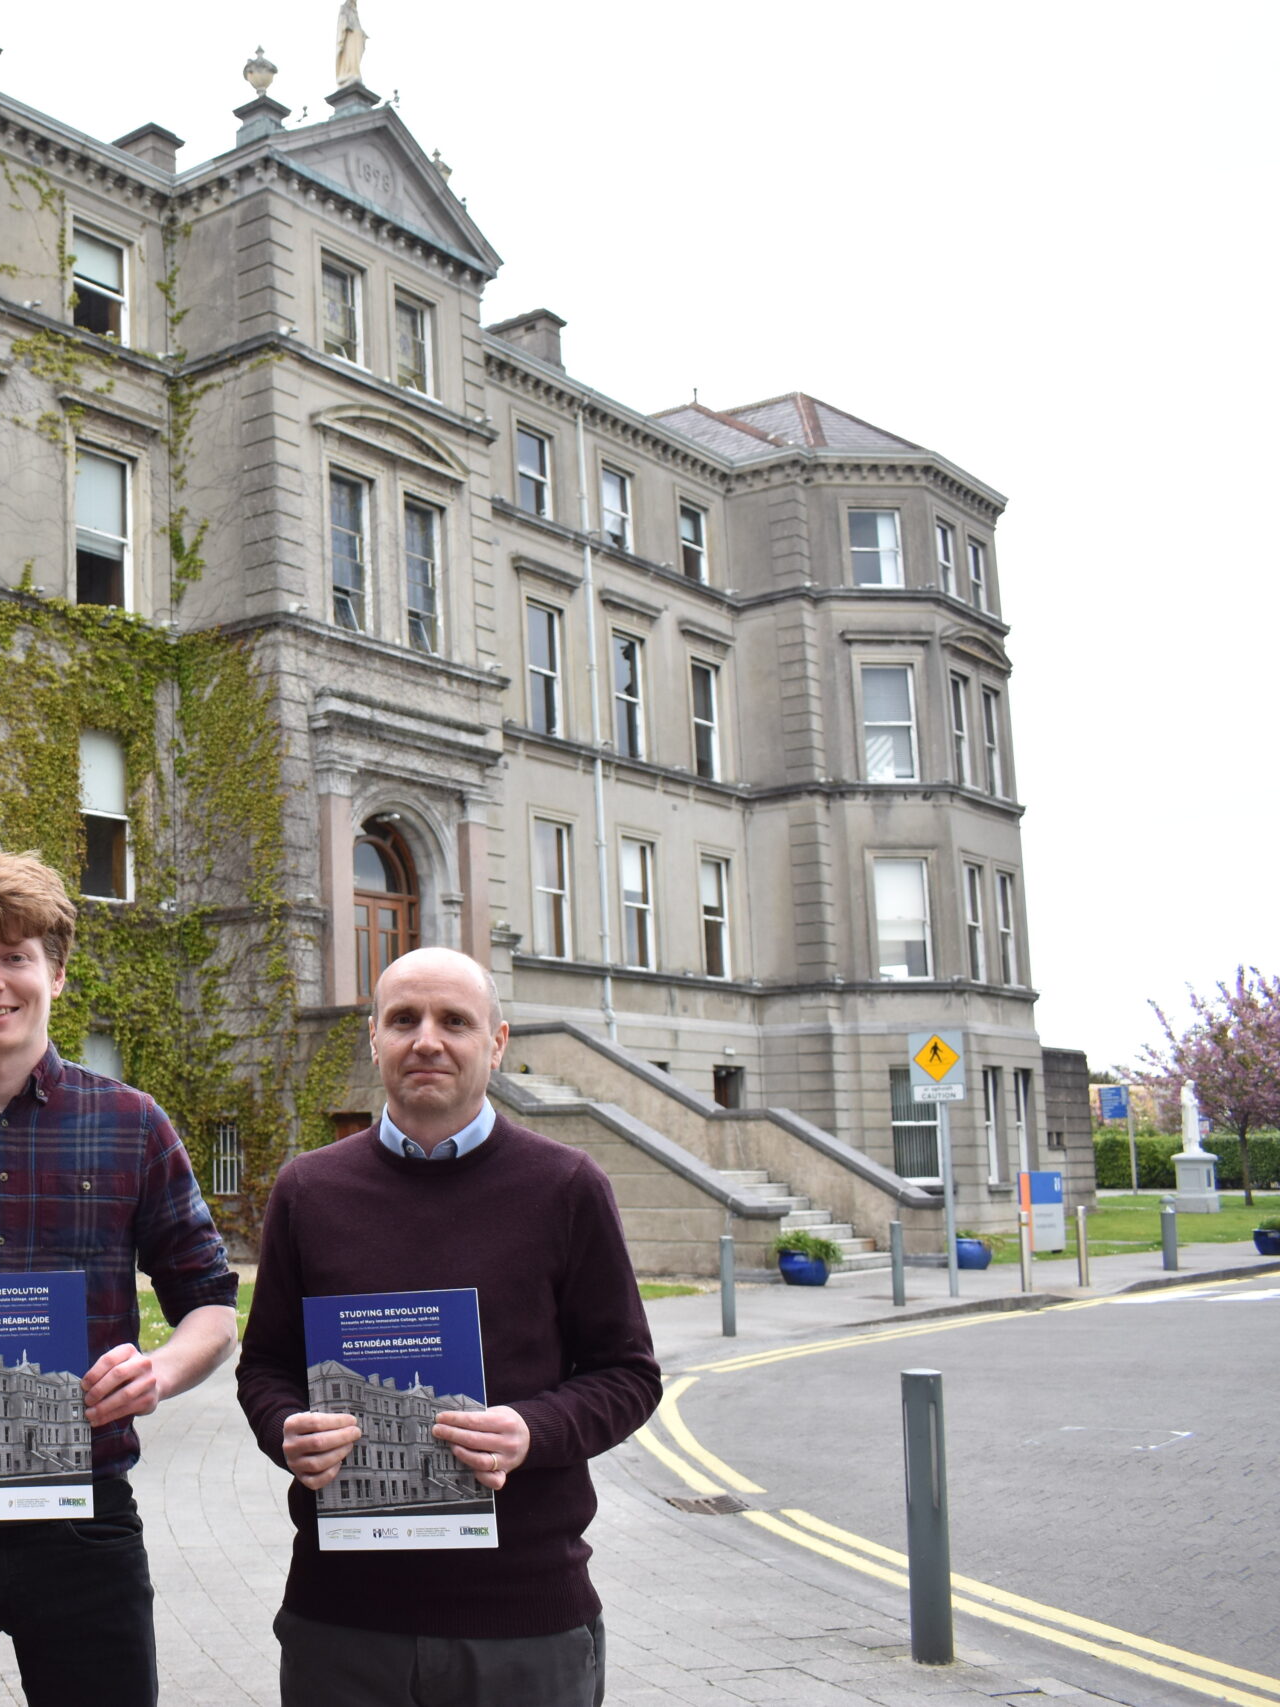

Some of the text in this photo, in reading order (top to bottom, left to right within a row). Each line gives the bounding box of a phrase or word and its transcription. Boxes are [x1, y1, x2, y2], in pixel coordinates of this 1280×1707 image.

[339, 1306, 439, 1319] STUDYING REVOLUTION
[2, 1315, 50, 1324] RÉABHLÓIDE
[342, 1336, 442, 1349] AG STAIDÉAR RÉABHLÓIDE
[58, 1497, 87, 1507] LIMERICK
[381, 1527, 399, 1536] MIC
[459, 1526, 489, 1536] LIMERICK
